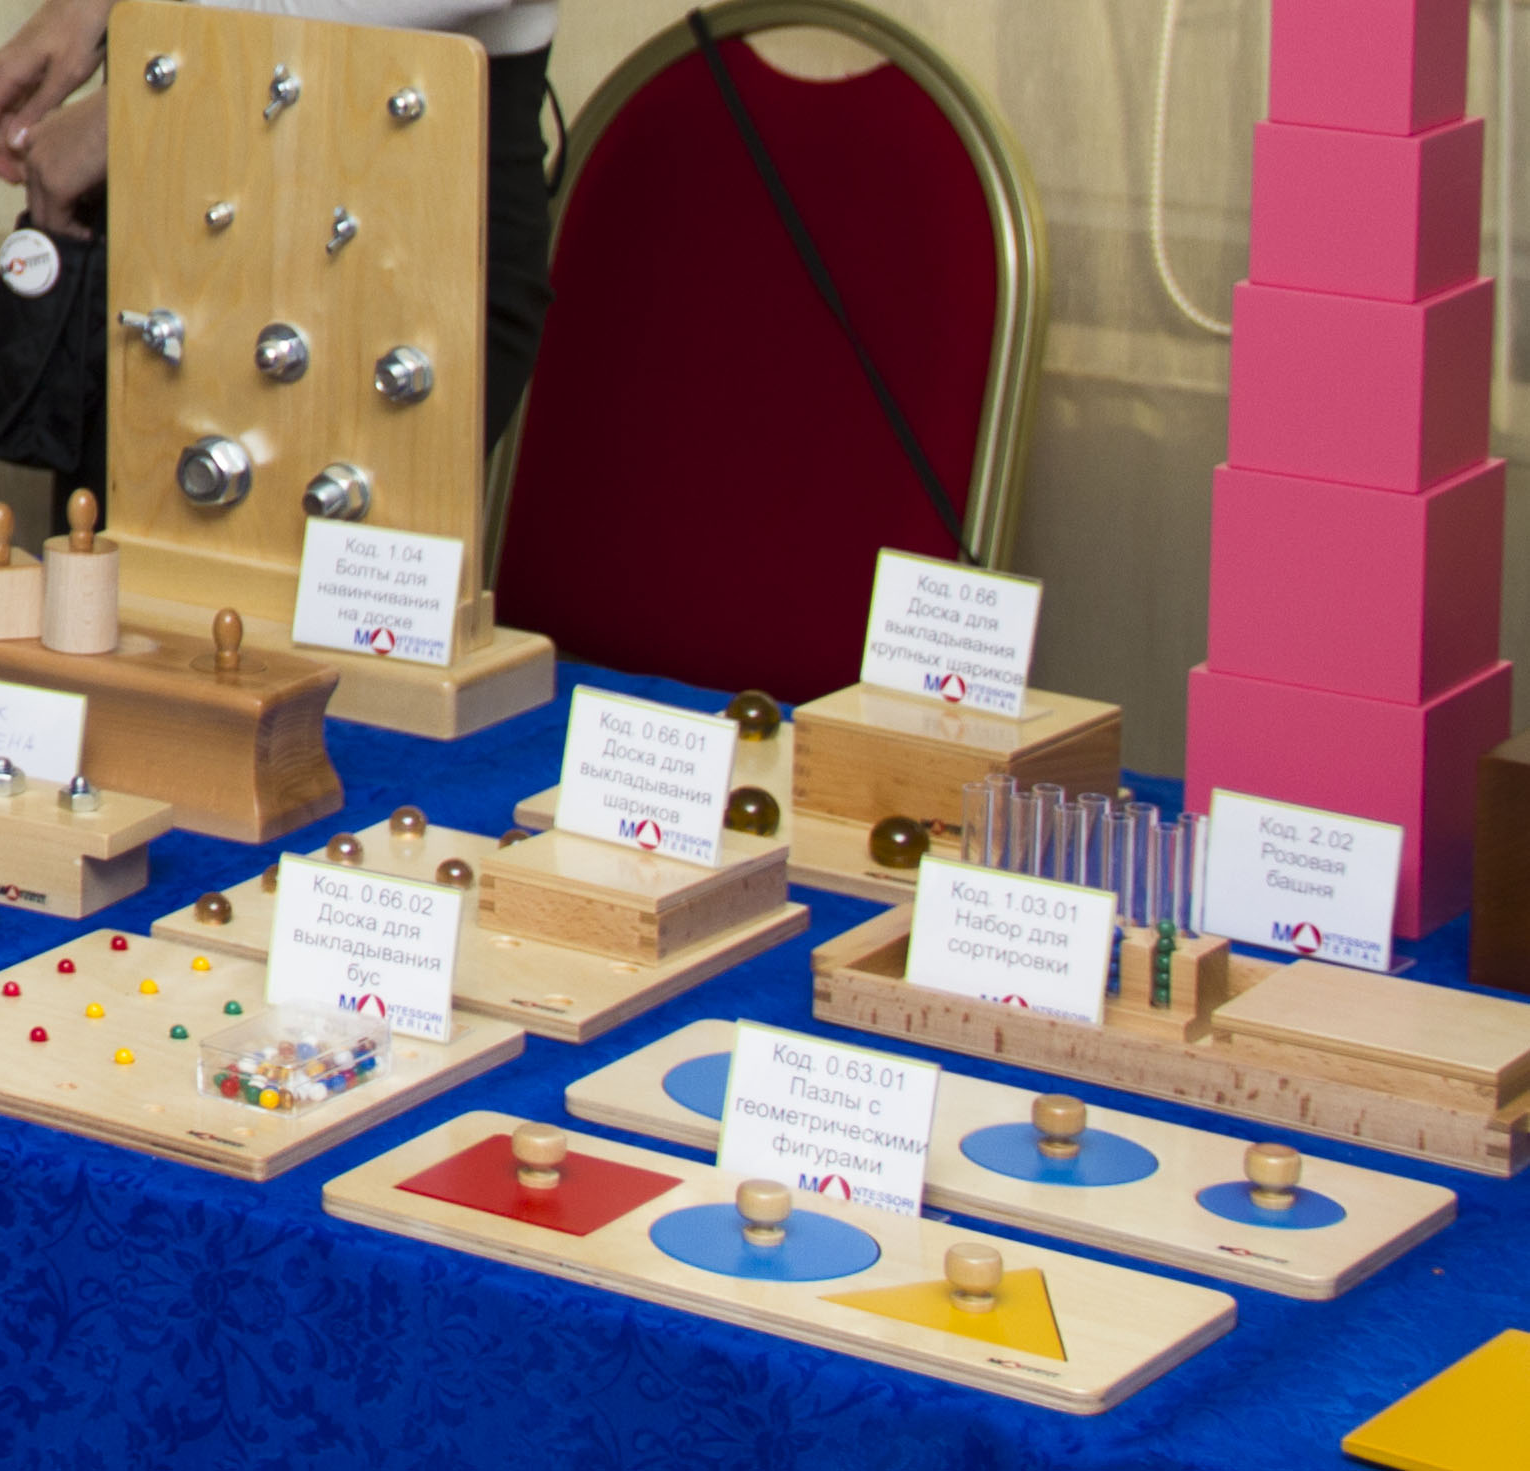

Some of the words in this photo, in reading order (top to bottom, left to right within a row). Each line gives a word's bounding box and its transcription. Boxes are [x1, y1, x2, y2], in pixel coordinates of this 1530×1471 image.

[389, 544, 423, 563] 1.04
[335, 558, 390, 581] Болты
[394, 571, 428, 587] для
[317, 582, 440, 611] навинчивания
[959, 584, 998, 607] 0.66
[337, 606, 358, 620] на
[362, 610, 413, 629] доске
[906, 596, 960, 623] Доска
[964, 613, 999, 633] для
[884, 619, 1016, 660] выкладывания
[870, 642, 941, 667] крупных
[945, 657, 1024, 685] шариков
[641, 721, 706, 753] 0.66.01
[602, 737, 656, 767] Доска
[660, 757, 695, 775] для
[579, 761, 712, 806] выкладывания
[602, 793, 680, 824] шариков
[1309, 826, 1354, 852] 2.02
[1260, 842, 1346, 876] Розовая
[361, 884, 434, 917] 0.66.02
[1266, 870, 1334, 899] башня
[317, 902, 378, 931] Доска
[382, 919, 421, 940] для
[1005, 892, 1077, 923] 1.03.01
[954, 908, 1022, 941] Набор
[1027, 928, 1069, 947] для
[293, 928, 442, 972] выкладывания
[947, 937, 1070, 975] сортировки
[347, 963, 381, 987] бус
[825, 1055, 905, 1091] 0.63.01
[789, 1076, 861, 1112] Пазлы
[868, 1099, 882, 1115] с
[735, 1097, 929, 1157] геометрическими
[772, 1133, 882, 1175] фигурами
